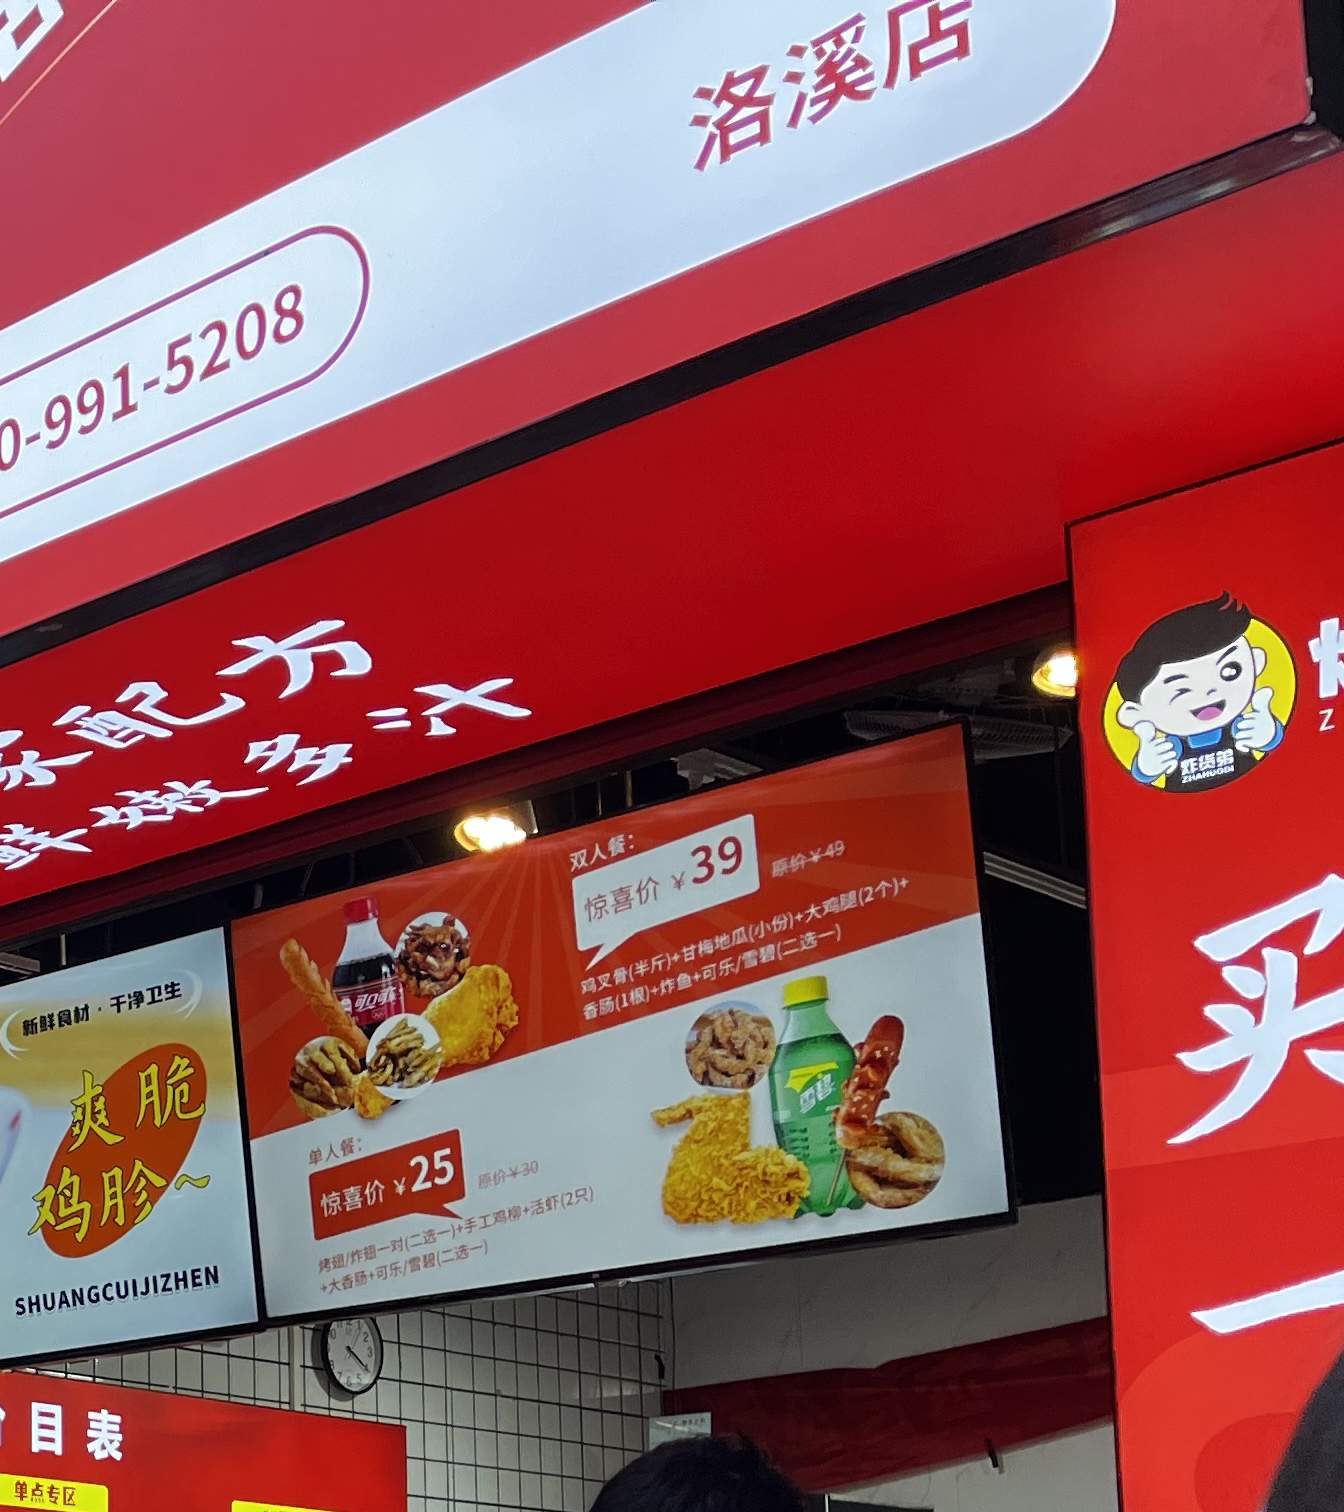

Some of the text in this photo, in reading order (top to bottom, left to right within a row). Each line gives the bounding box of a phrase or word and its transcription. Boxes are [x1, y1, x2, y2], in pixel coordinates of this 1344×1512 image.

[689, 0, 973, 172] 洛溪店
[1181, 749, 1234, 776] 炸货弟
[1182, 765, 1235, 783] ZHAHUODI
[584, 876, 660, 922] 惊喜价
[67, 1054, 207, 1153] 爽脆
[320, 1179, 385, 1218] 惊喜价
[15, 1265, 220, 1316] SHUANGCUIJIZHEN
[14, 1480, 76, 1506] 单点专区
